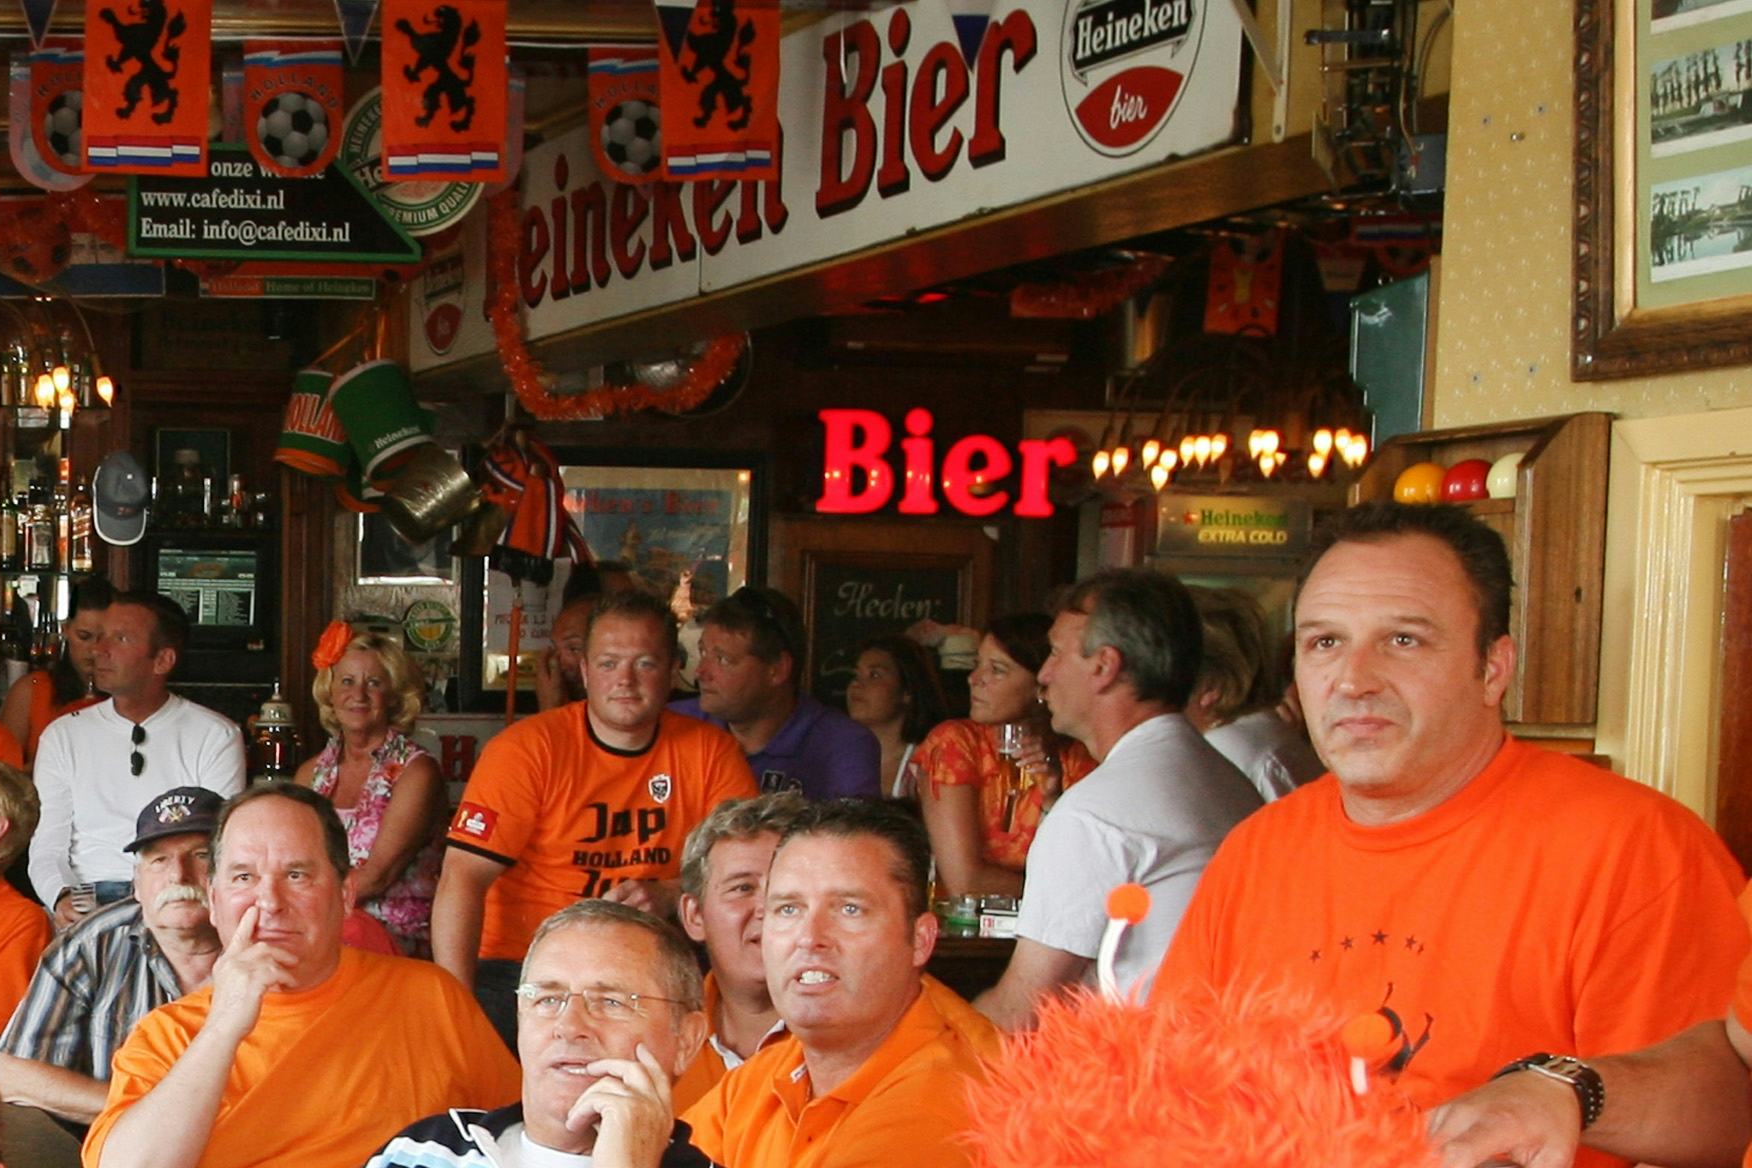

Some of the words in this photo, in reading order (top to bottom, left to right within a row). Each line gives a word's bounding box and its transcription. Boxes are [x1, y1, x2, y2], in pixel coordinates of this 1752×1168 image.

[1075, 0, 1188, 60] Heineken
[250, 77, 340, 110] HOLLAND
[1110, 84, 1148, 130] bier
[211, 161, 253, 177] onze
[517, 152, 789, 308] eineken
[816, 8, 1037, 219] Bier
[141, 189, 285, 210] www.cafedixi.nl
[141, 218, 197, 239] Email:
[203, 219, 350, 245] info@cafedixi.nl
[815, 407, 1078, 519] Bier
[1198, 529, 1246, 544] EXTRA
[1249, 530, 1287, 544] COLD
[573, 847, 672, 868] HOLLAND
